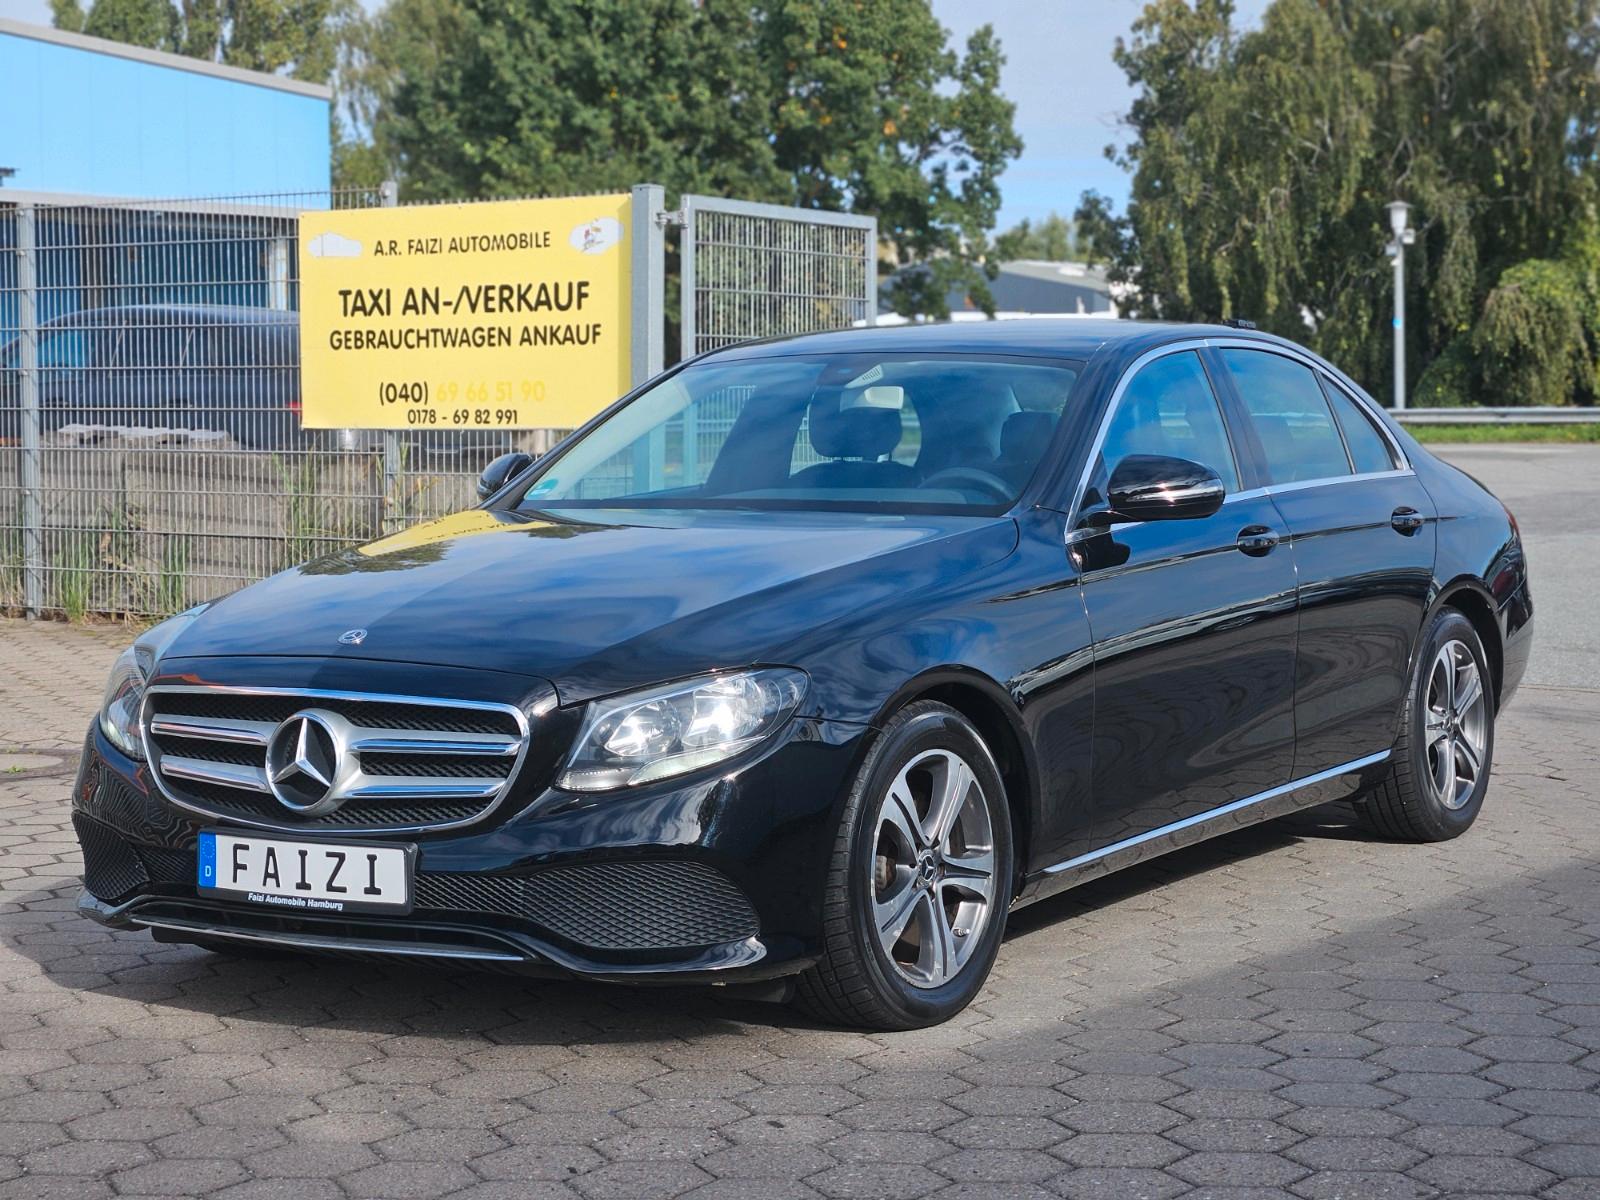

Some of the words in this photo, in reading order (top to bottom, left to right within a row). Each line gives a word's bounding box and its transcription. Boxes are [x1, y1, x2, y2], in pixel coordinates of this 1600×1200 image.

[374, 239, 402, 256] A.R.
[408, 237, 442, 255] FAIZI
[448, 231, 551, 253] AUTOMOBILE
[338, 288, 391, 317] TAXI
[402, 281, 590, 315] AN-/VERKAUF
[330, 326, 511, 350] GEBRAUCHTWAGEN
[519, 324, 602, 347] ANKAUF
[379, 381, 429, 406] (040)
[436, 382, 458, 403] 69
[465, 381, 488, 402] 66
[496, 381, 512, 402] 51
[520, 380, 545, 402] 90
[407, 409, 437, 424] 0178
[452, 409, 469, 424] 69
[474, 409, 491, 424] 82
[495, 409, 518, 424] 991
[204, 866, 212, 877] D
[232, 843, 382, 896] FAIZI
[248, 892, 264, 902] Faizi
[265, 895, 306, 907] Automobile
[307, 899, 343, 911] Hamburg
